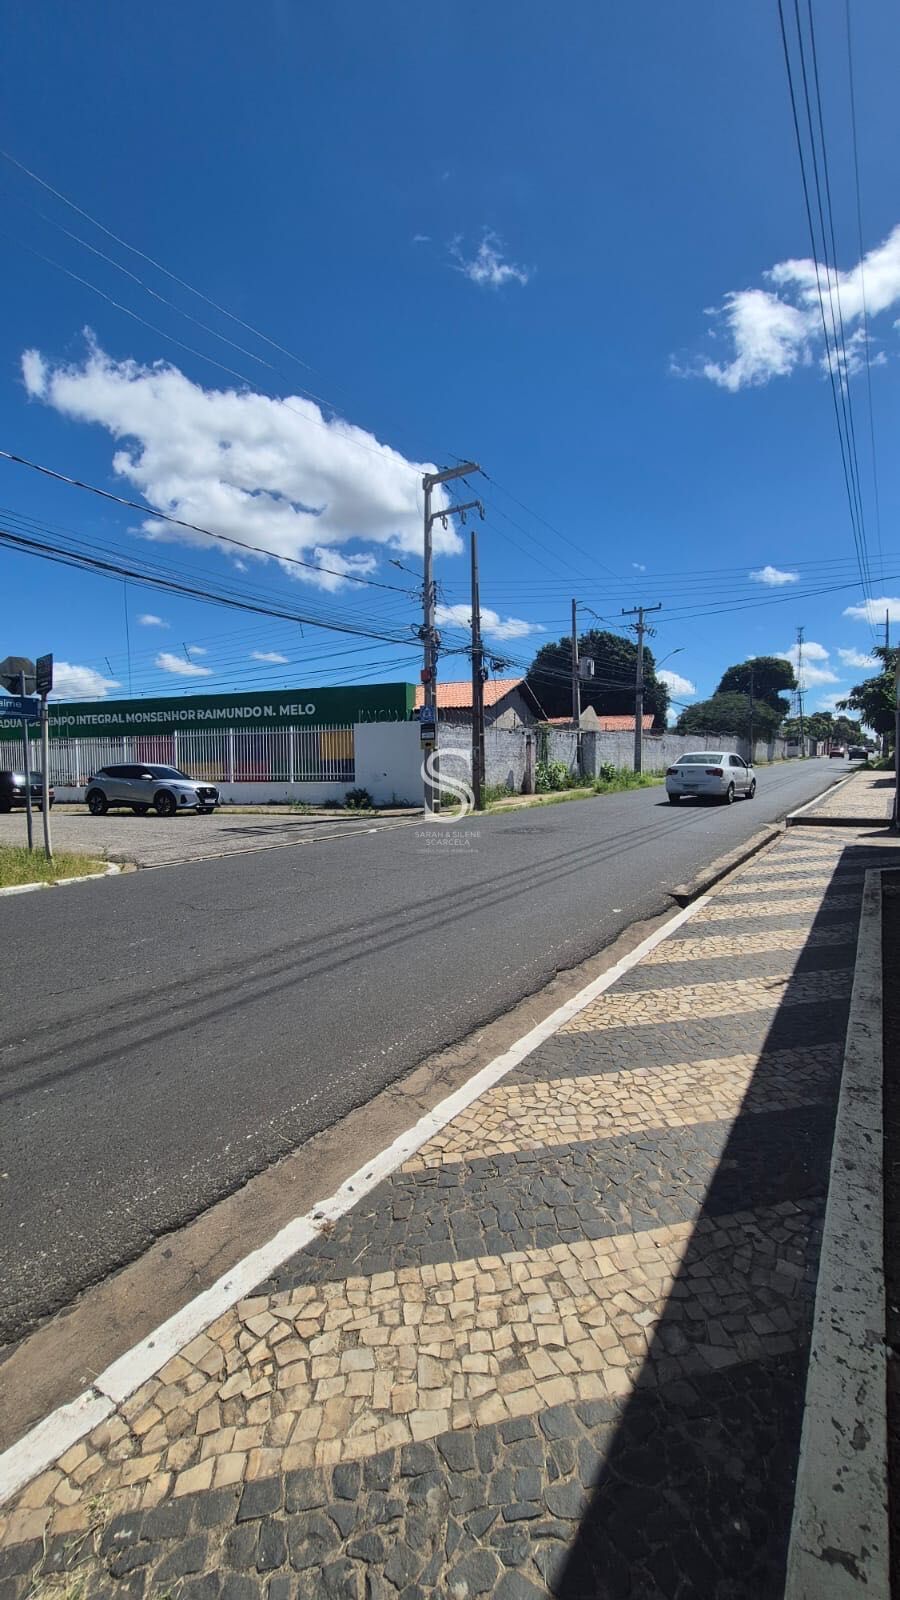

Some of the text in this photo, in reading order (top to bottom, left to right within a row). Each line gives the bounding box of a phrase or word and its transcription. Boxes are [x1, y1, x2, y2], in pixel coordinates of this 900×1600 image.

[48, 715, 75, 726] EMPO
[76, 713, 125, 725] INTEGRAL
[125, 710, 196, 723] MONSENHOR
[197, 706, 262, 719] RAIMUNDO
[263, 705, 276, 716] N.
[279, 703, 316, 716] MELO
